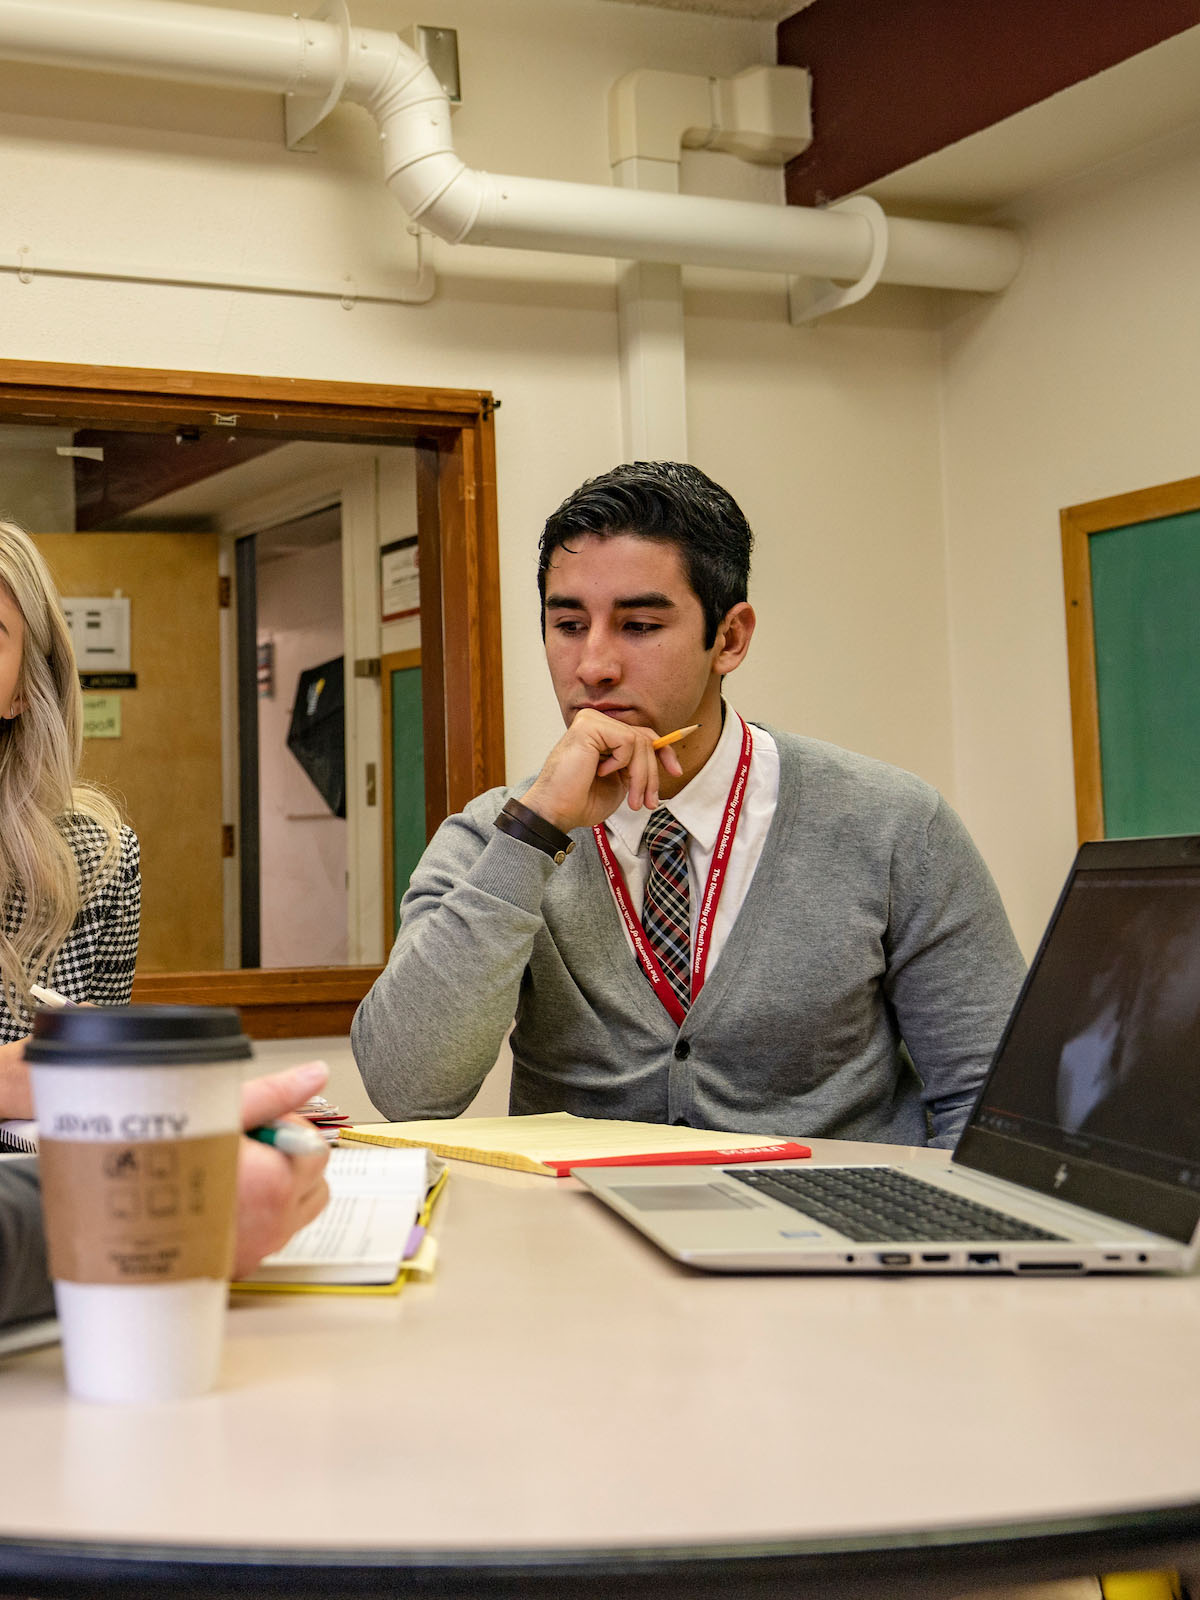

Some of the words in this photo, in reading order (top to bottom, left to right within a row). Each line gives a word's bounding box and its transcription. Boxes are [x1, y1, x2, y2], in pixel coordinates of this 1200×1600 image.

[740, 764, 748, 777] The
[730, 777, 744, 809] University
[728, 807, 736, 817] of
[724, 815, 734, 835] South
[596, 834, 610, 867] University
[717, 834, 730, 860] Dakota
[608, 866, 616, 880] The
[711, 868, 720, 882] The
[616, 886, 627, 911] Dakota
[702, 882, 717, 916] University
[624, 910, 636, 930] South
[700, 915, 708, 926] of
[630, 929, 639, 938] of
[698, 925, 707, 947] South
[635, 937, 653, 970] University
[694, 946, 703, 974] Dakota
[650, 969, 661, 984] The
[120, 1112, 189, 1138] CITY
